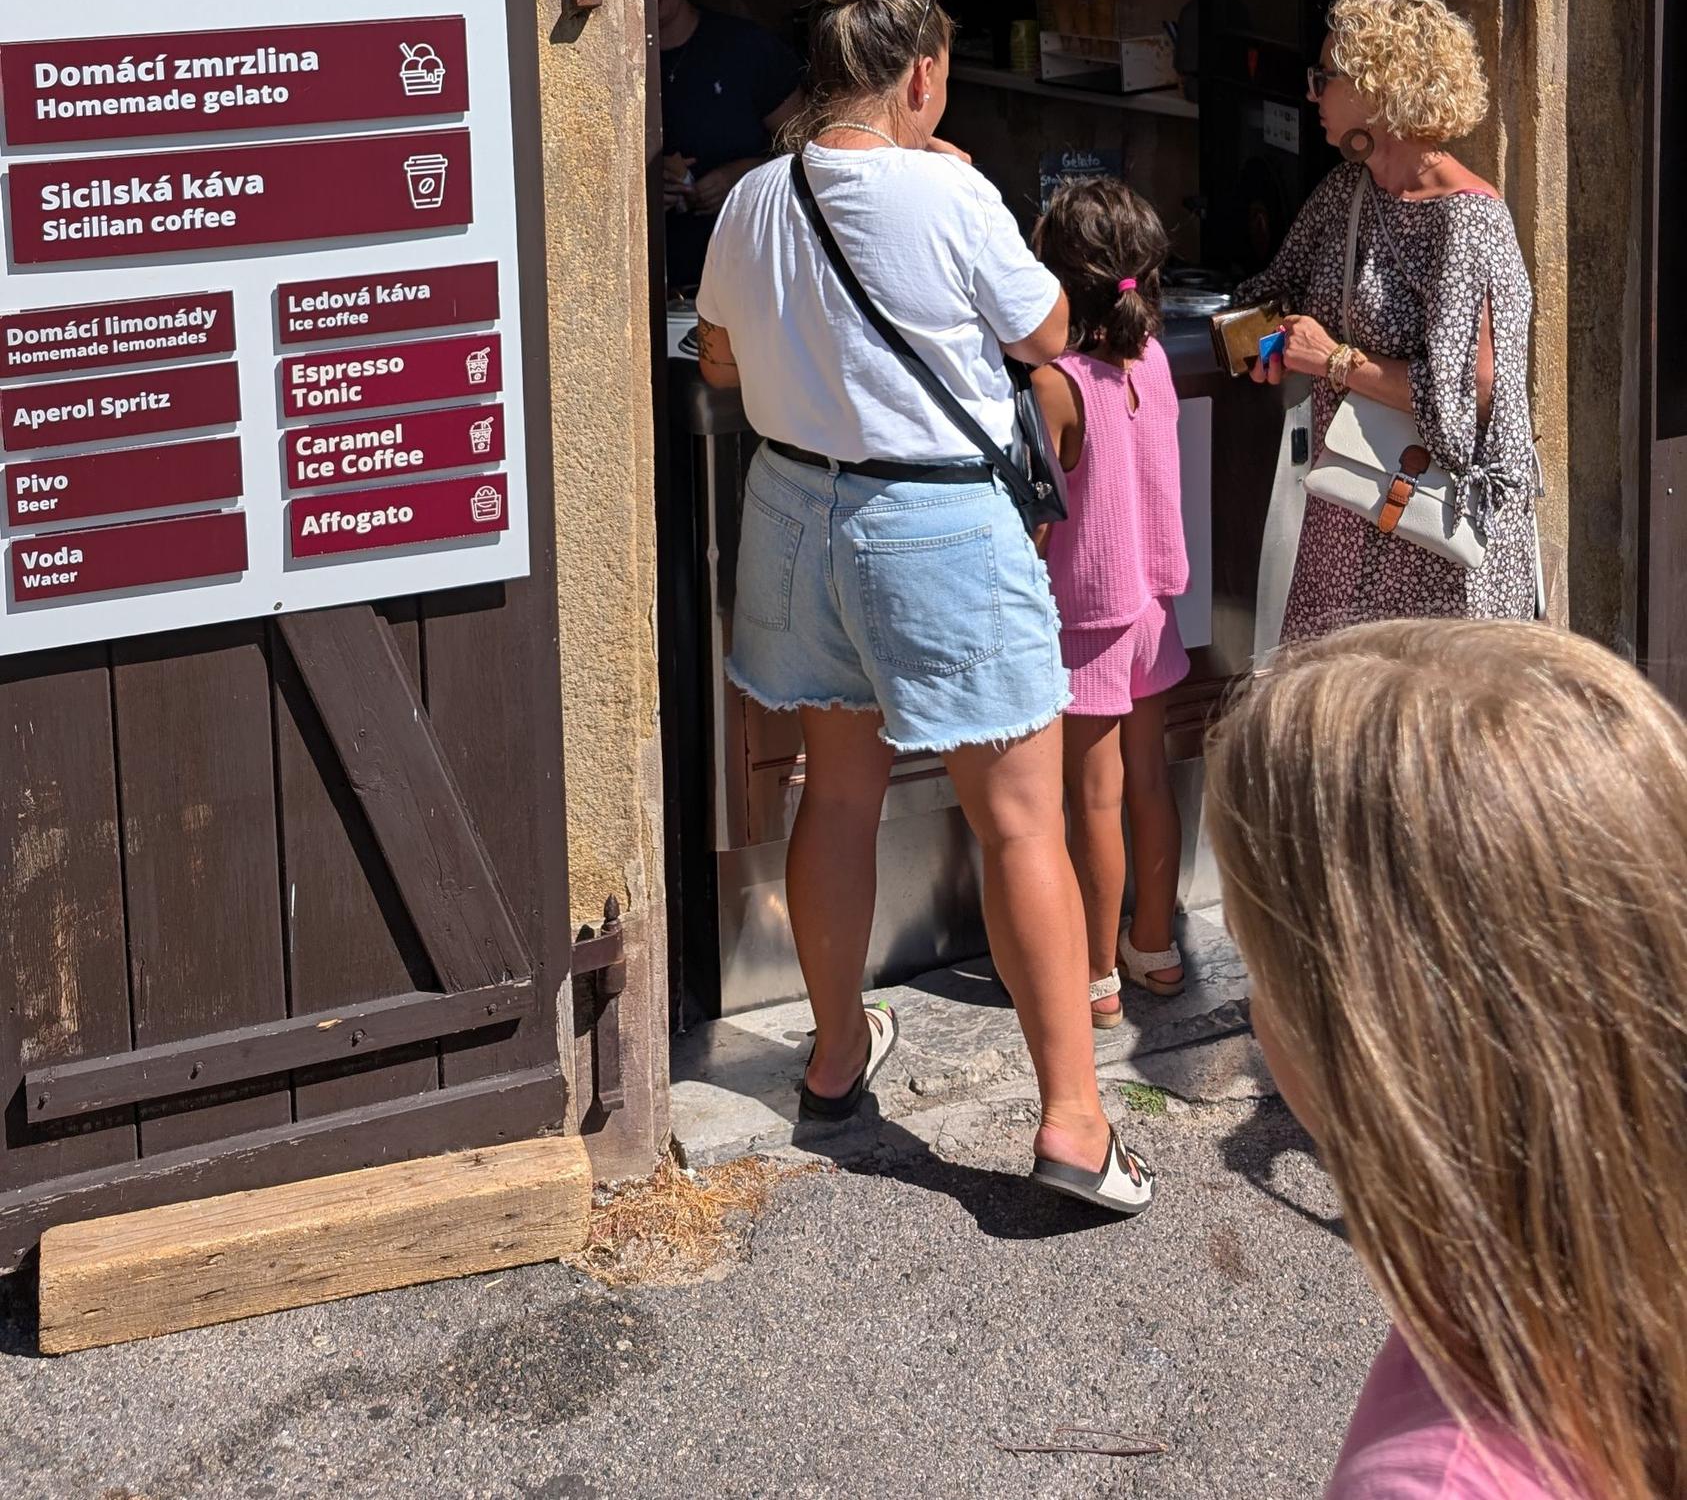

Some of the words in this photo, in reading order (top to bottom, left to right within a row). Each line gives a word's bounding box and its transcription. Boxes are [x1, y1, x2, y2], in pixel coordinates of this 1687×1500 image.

[35, 55, 166, 88] Domácí
[175, 46, 319, 79] zmrzlina
[37, 89, 196, 120] Homemade
[204, 85, 289, 114] gelato
[1061, 152, 1101, 168] Gelato
[41, 174, 173, 211] Sicilská
[183, 171, 264, 200] káva
[43, 212, 143, 241] Sicilian
[151, 208, 236, 234] coffee
[289, 286, 370, 313] Ledová
[376, 281, 430, 302] káva
[6, 320, 98, 347] Domácí
[105, 307, 217, 335] limonády
[289, 316, 313, 331] Ice
[316, 311, 369, 328] coffee
[8, 343, 108, 365] Homemade
[113, 331, 207, 354] lemonades
[292, 356, 404, 385] Espresso
[13, 399, 94, 430] Aperol
[101, 392, 170, 419] Spritz
[292, 384, 362, 408] Tonic
[296, 425, 402, 456] Caramel
[298, 457, 334, 480] Ice
[342, 448, 423, 474] Coffee
[16, 473, 68, 494] Pivo
[17, 496, 58, 513] Beer
[302, 505, 413, 536] Affogato
[22, 548, 83, 569] Voda
[23, 569, 78, 588] Water
